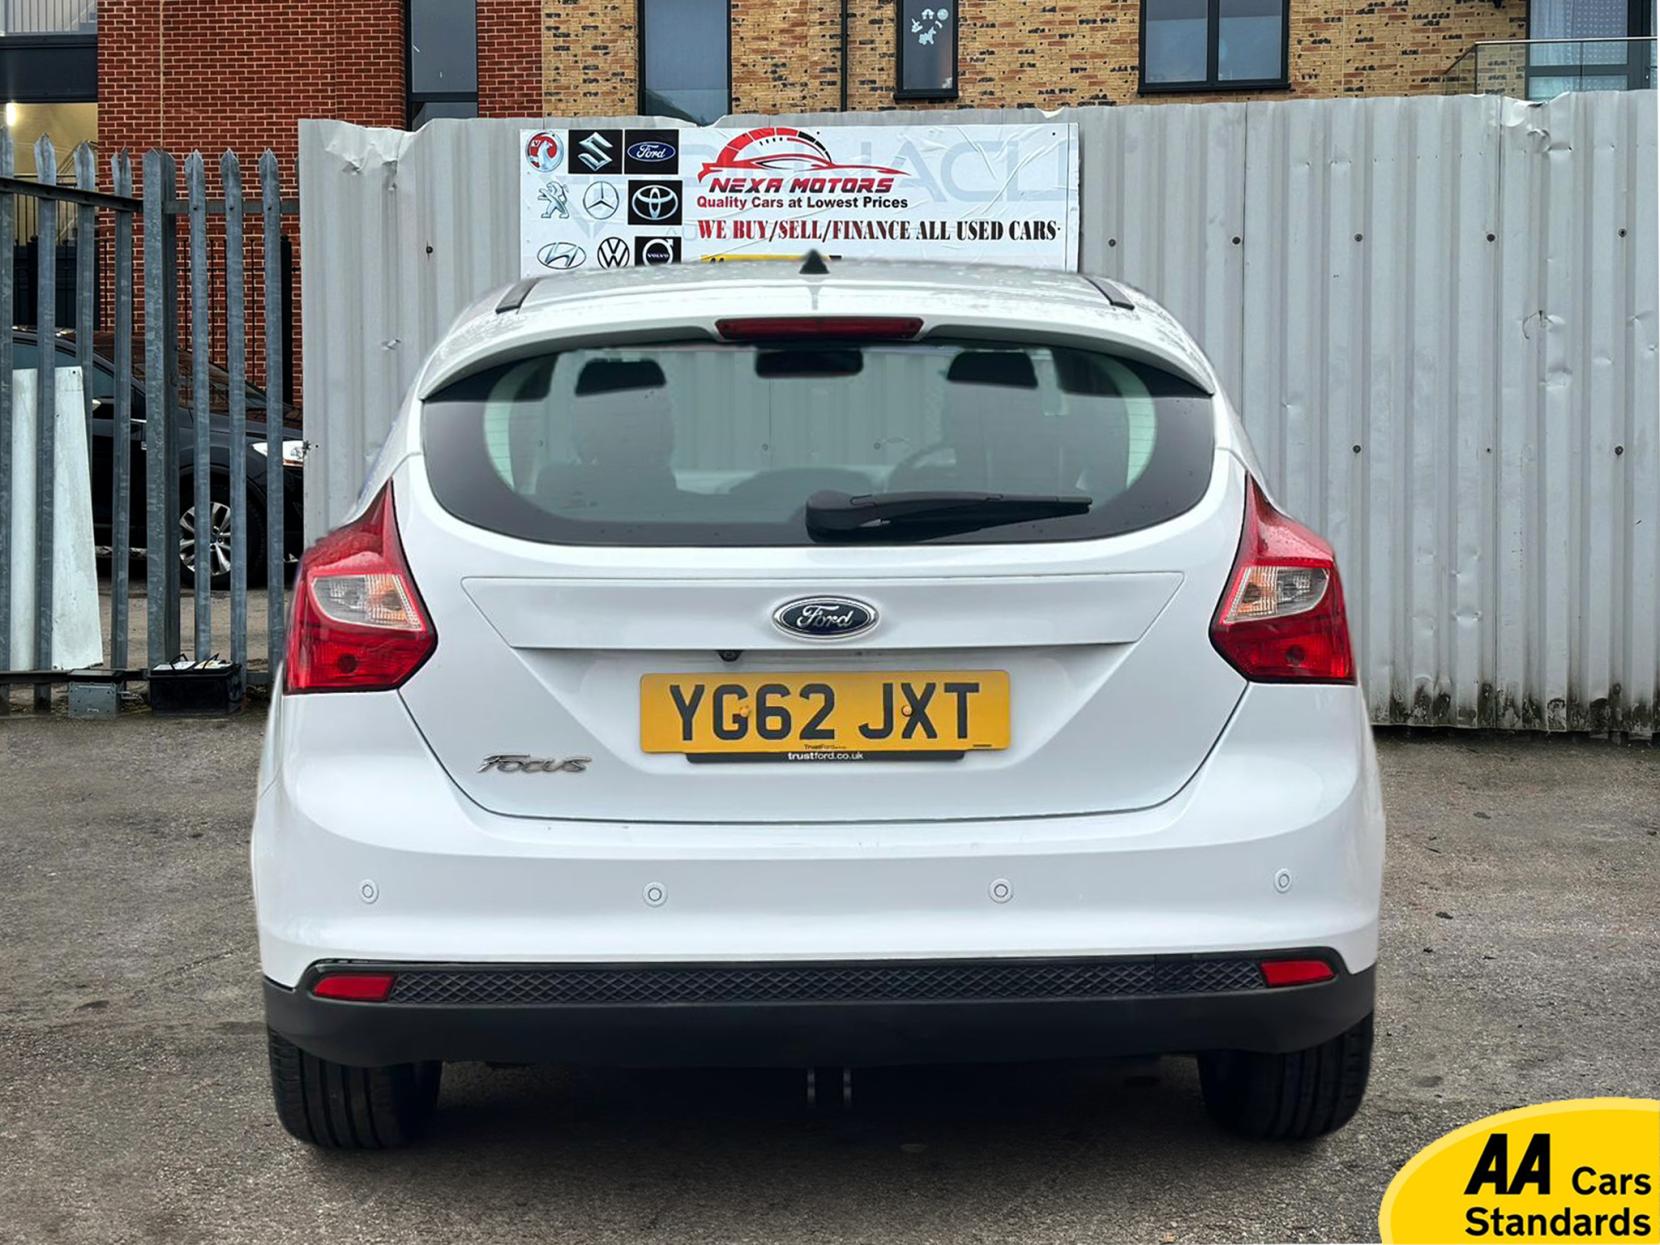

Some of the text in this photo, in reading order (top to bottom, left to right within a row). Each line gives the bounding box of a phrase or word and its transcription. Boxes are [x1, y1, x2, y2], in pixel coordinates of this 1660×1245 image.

[636, 143, 666, 159] Ford
[709, 177, 895, 193] NEXA MOTORS
[697, 195, 908, 210] Quality Cars at Lowest Prices
[697, 219, 727, 240] WE
[733, 219, 910, 242] BUY/SELL/FINANCE
[916, 220, 951, 240] ALL
[956, 220, 1004, 240] USED
[796, 605, 854, 627] Ford
[669, 681, 980, 741] YG62 JXT
[788, 751, 864, 761] trustford.co.uk
